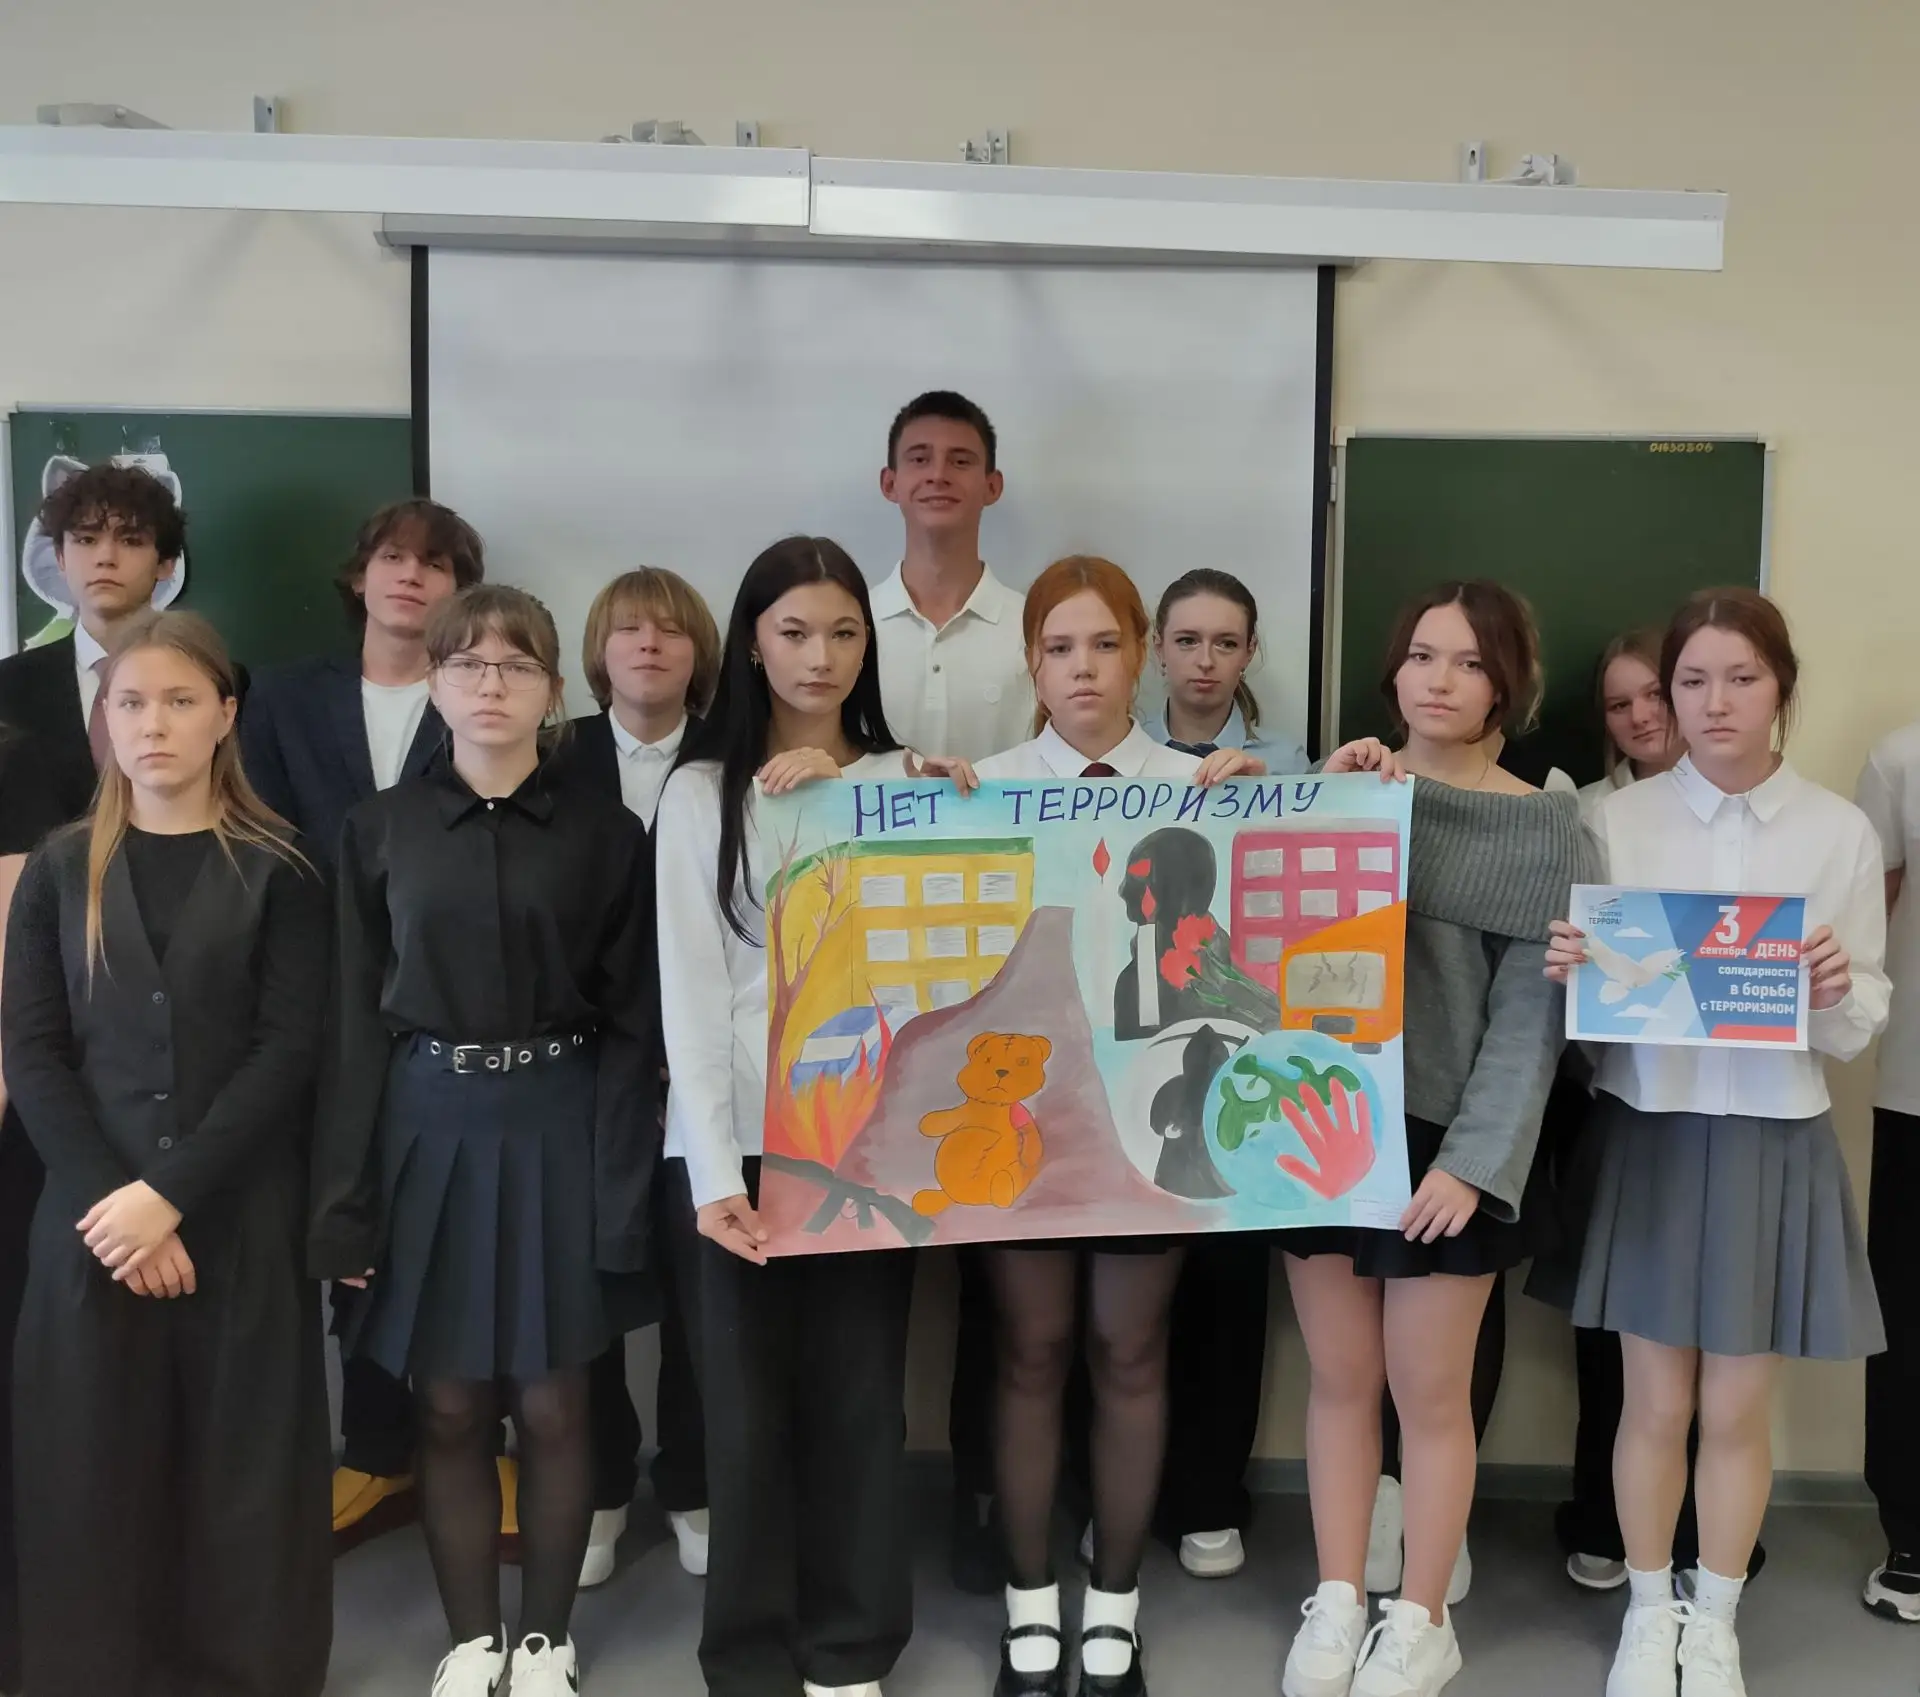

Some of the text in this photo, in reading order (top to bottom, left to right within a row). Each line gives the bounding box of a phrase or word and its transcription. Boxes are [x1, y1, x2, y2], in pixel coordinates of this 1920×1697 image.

[852, 781, 1324, 837] НЕТ ТЕРРОРИЗМУ
[1715, 905, 1740, 944] 3
[1699, 943, 1798, 959] сентября ДЕНЬ
[1718, 966, 1797, 978] солидарности
[1729, 982, 1796, 999] в борьбе
[1700, 1000, 1795, 1014] с ТЕРРОРИЗМОМ
